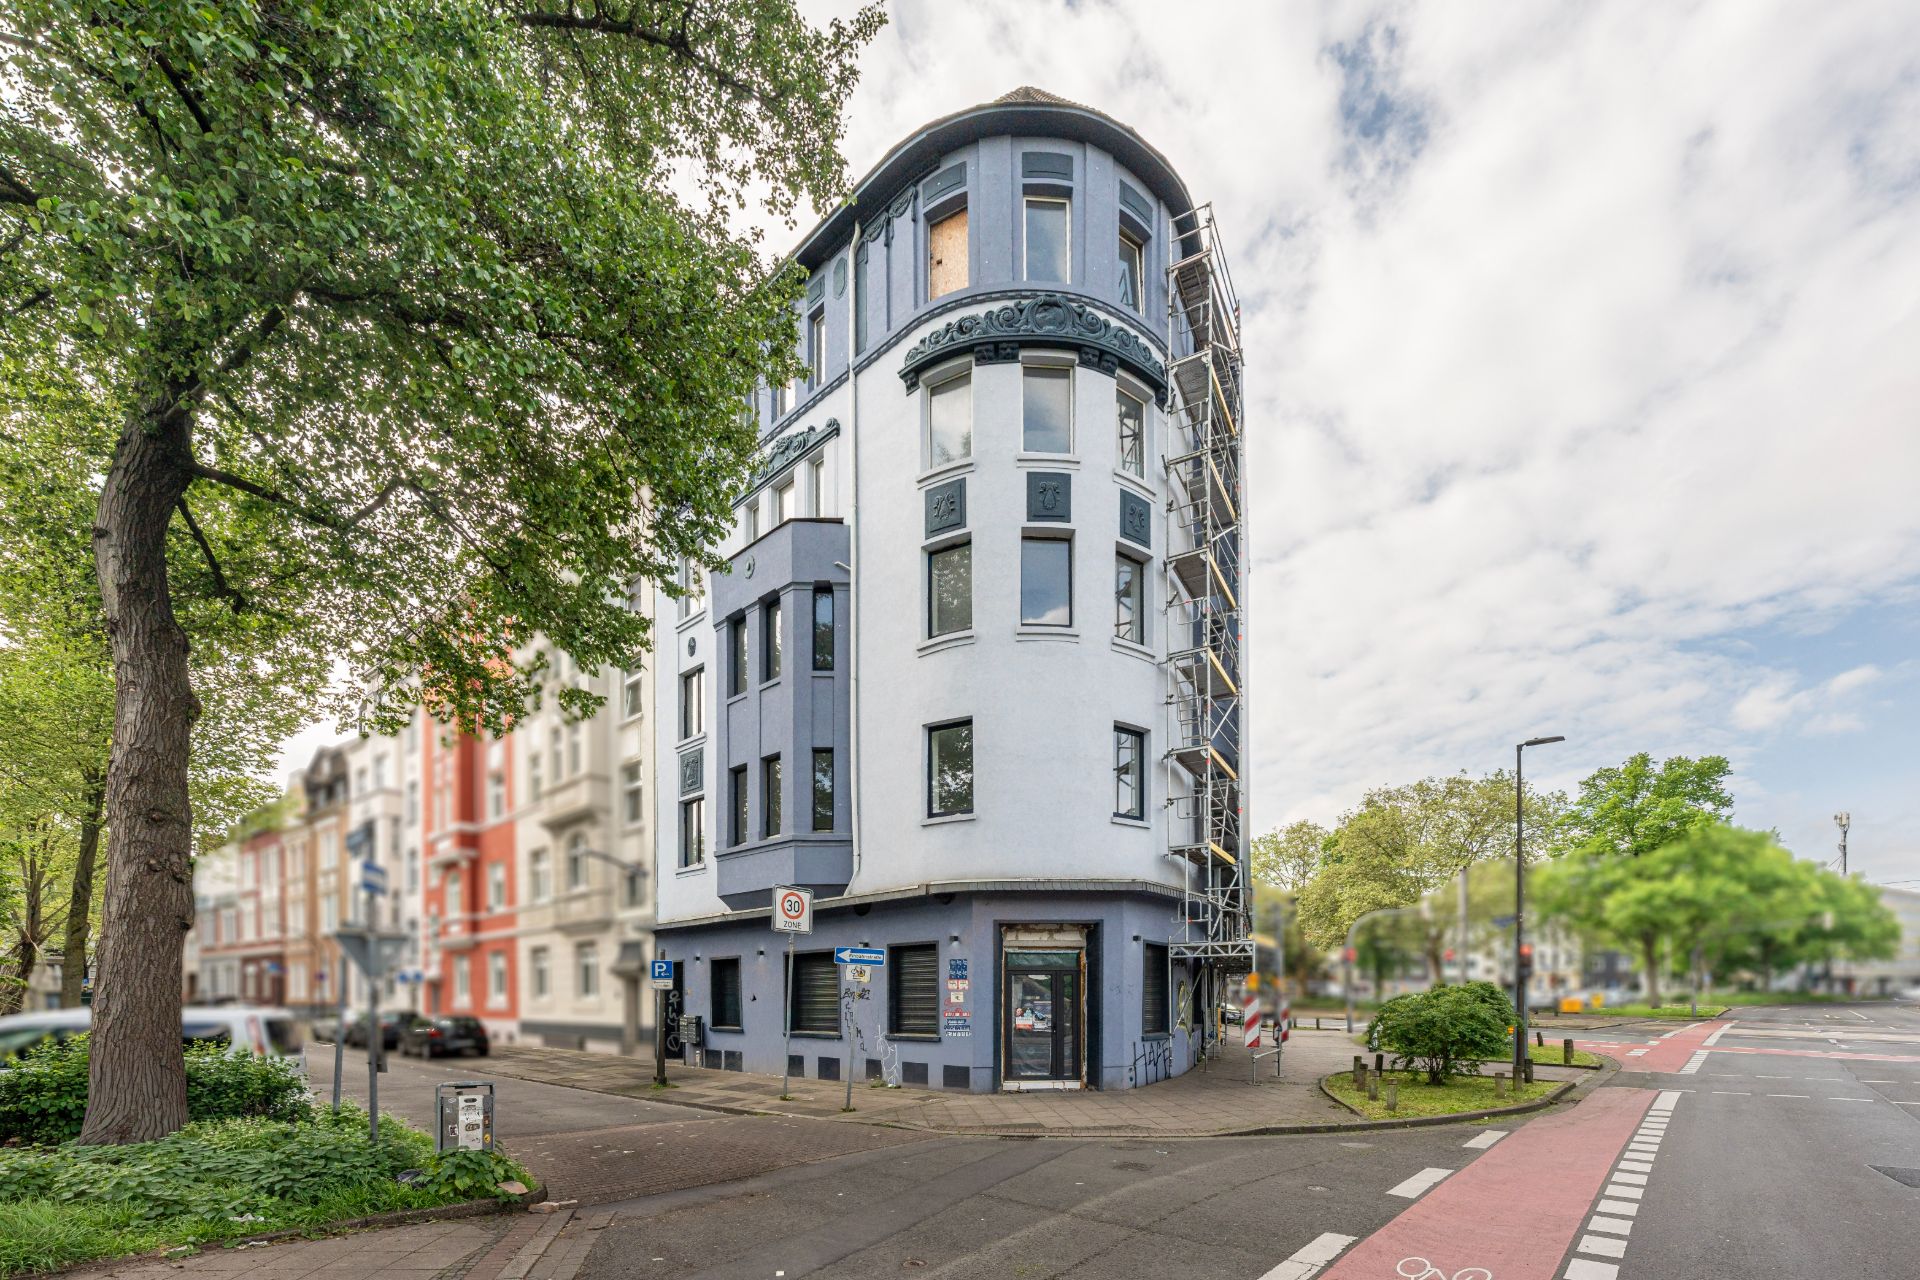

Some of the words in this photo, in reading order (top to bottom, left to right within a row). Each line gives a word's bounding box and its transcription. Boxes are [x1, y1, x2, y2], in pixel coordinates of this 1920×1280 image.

[786, 899, 800, 913] 30
[783, 920, 802, 930] ZONE
[654, 962, 667, 977] P
